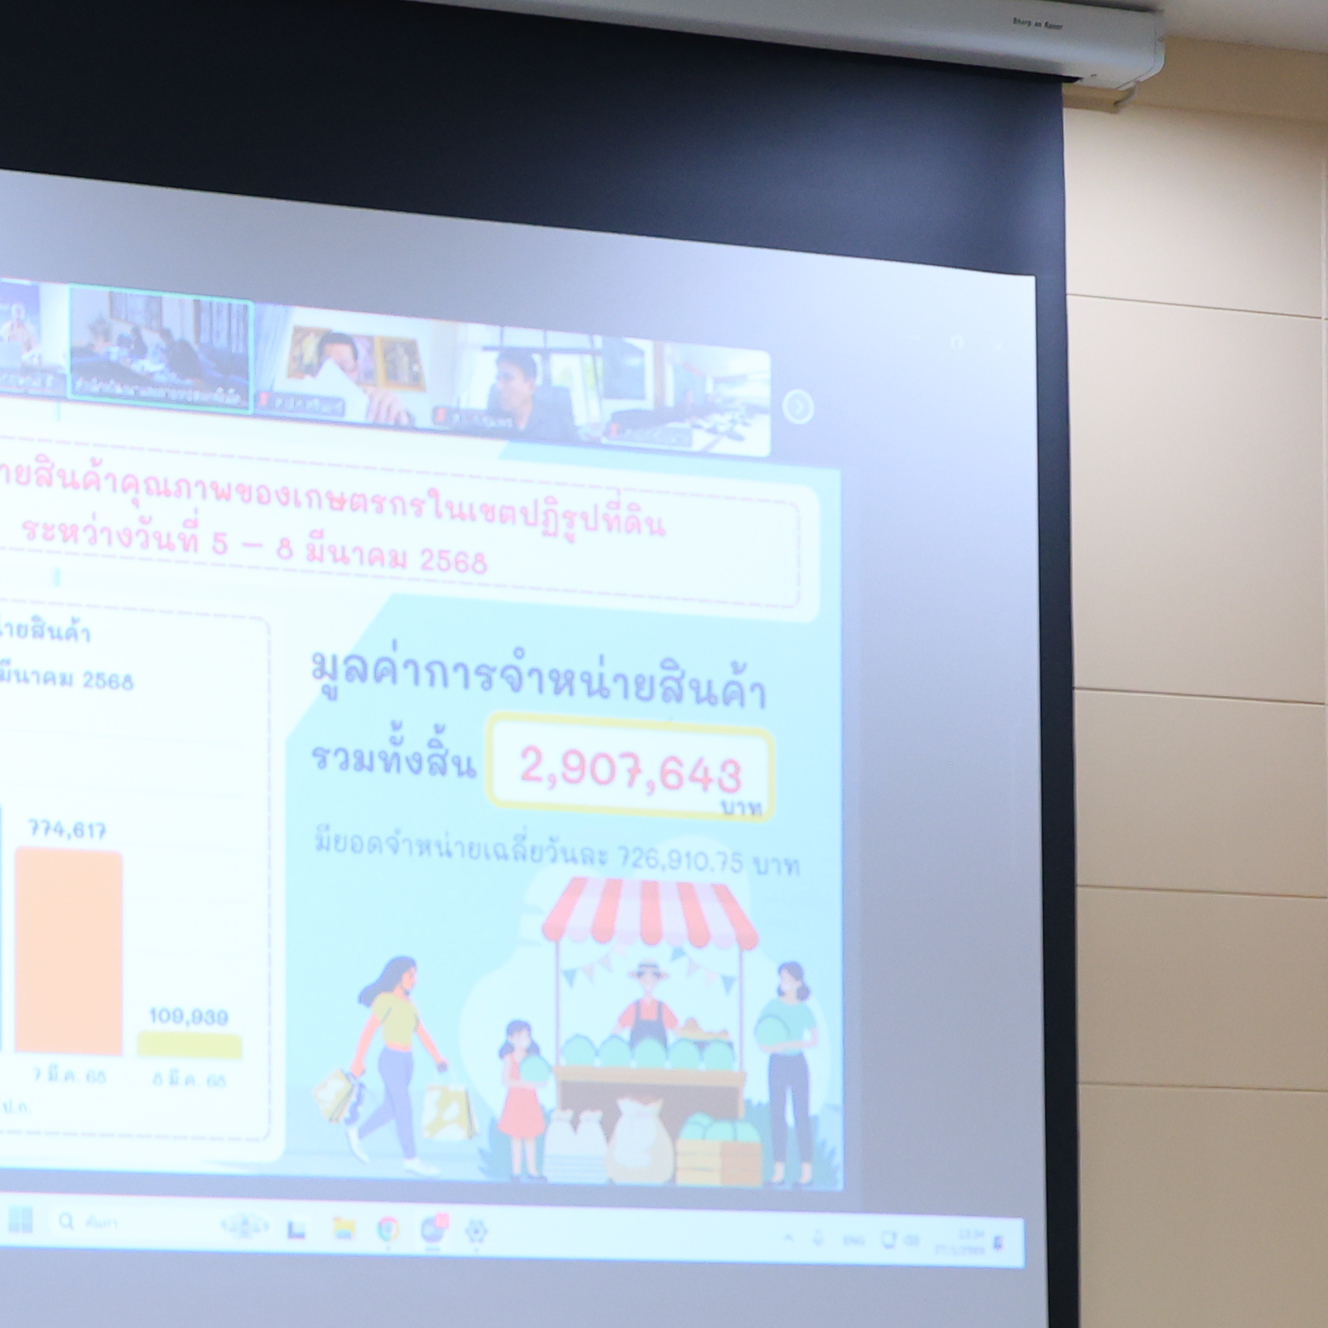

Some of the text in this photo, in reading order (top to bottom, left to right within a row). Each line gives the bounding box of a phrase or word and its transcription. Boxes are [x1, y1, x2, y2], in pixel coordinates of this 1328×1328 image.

[21, 505, 200, 553] ระหว่างวันที่
[211, 531, 229, 556] 5
[276, 536, 294, 561] 8
[305, 530, 408, 570] มีนาคม
[420, 547, 489, 576] 2568
[82, 669, 135, 691] 2568
[312, 638, 767, 709] มูลค่าการจำหน่ายสินค้า
[311, 719, 743, 796] รวมทั้งสิ้น 2,907,643
[720, 799, 764, 818] บาท
[28, 817, 107, 841] 774,617
[315, 823, 801, 877] มียอดจำหน่ายเฉลี่ยวันละ 726,910.75 บาท
[149, 1006, 230, 1027] 109,939
